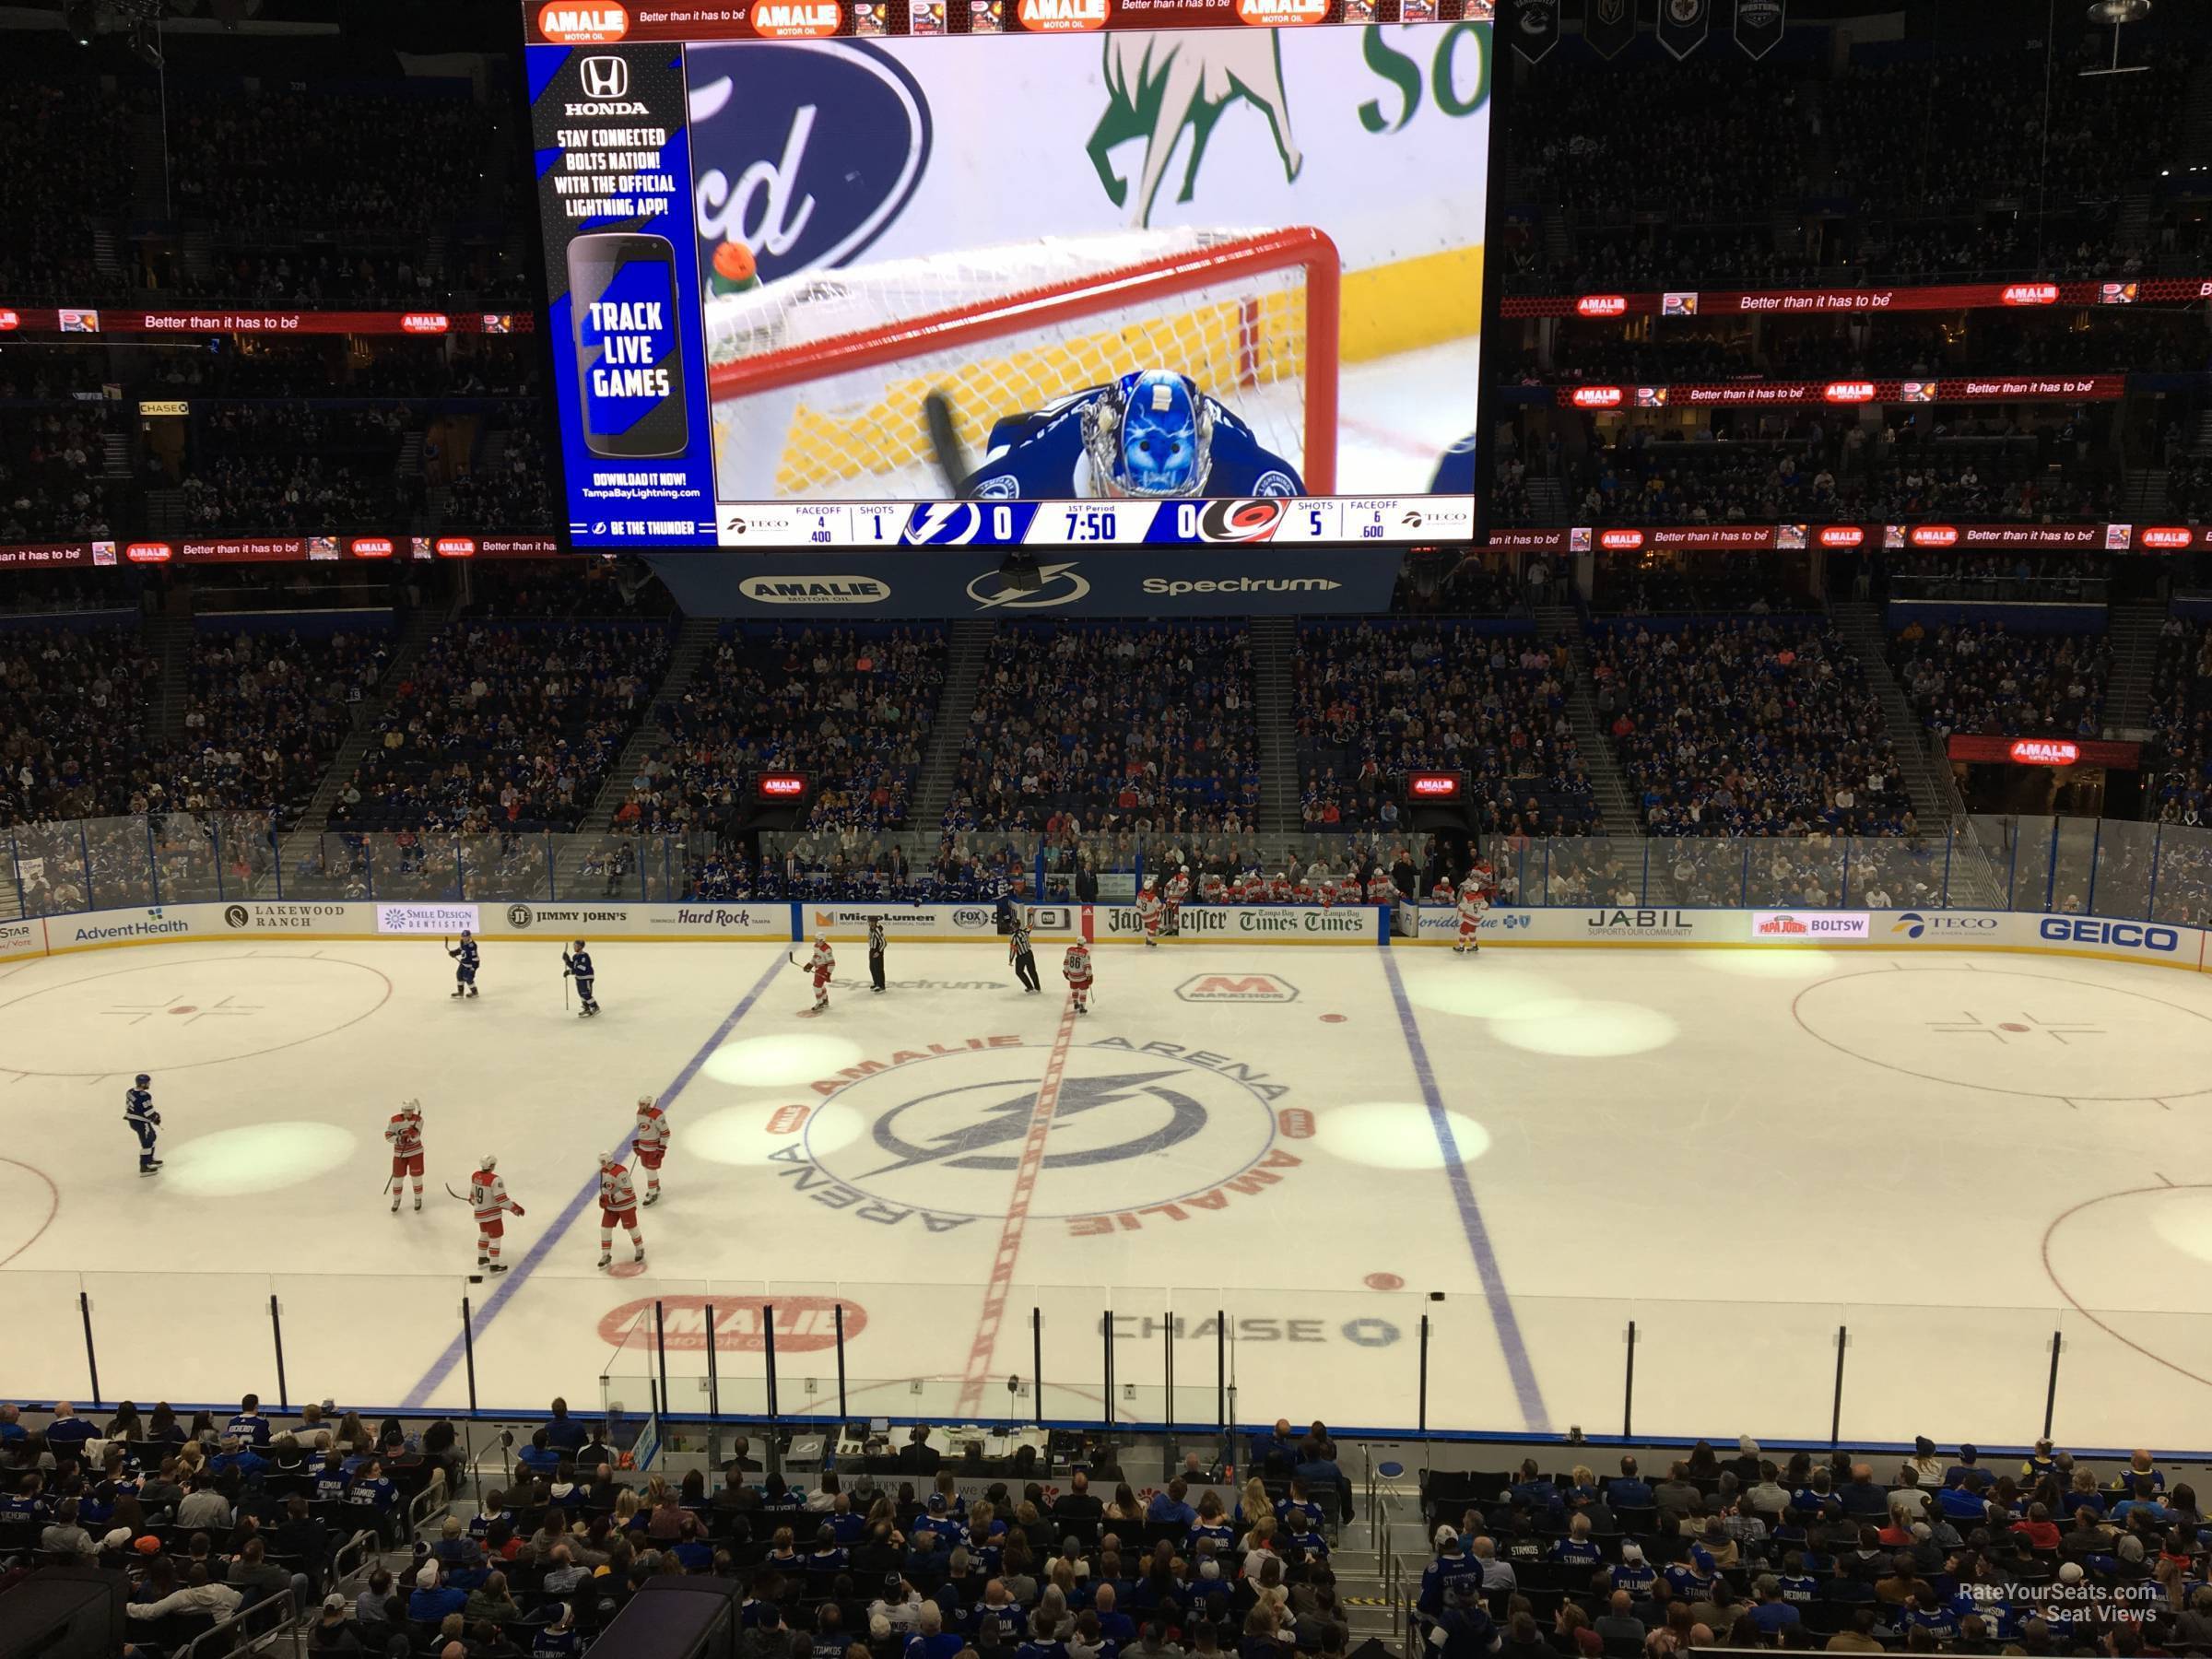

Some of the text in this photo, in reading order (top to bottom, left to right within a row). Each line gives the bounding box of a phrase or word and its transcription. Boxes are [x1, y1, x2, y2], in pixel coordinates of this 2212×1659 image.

[1024, 0, 1105, 19] AMALIE
[545, 10, 624, 31] AMALIE
[640, 10, 745, 22] Better than it has to be
[757, 5, 836, 27] AMALIE
[565, 102, 649, 115] HONDA
[557, 128, 665, 147] STAY CONNECTED
[566, 152, 660, 171] BOLTS NATION!
[554, 175, 676, 194] WITH THE OFFICIAL
[565, 198, 668, 217] LIGHTNING APP!
[2006, 288, 2056, 300] AMALIE
[1580, 298, 1625, 310] AMALIE
[1740, 294, 1889, 309] Better than it has to be
[146, 316, 298, 328] Better than it has to be
[404, 316, 447, 326] AMALIE
[590, 302, 662, 331] TRACK
[605, 335, 653, 364] LIVE
[593, 369, 669, 397] GAMES
[1967, 382, 2091, 393] Better than it has to be
[1575, 390, 1620, 401] AMALIE
[1691, 388, 1803, 399] Better than it has to be
[1828, 385, 1873, 396] AMALIE
[594, 473, 687, 486] DOWNLOAD IT NOW!
[582, 488, 700, 500] TampaBayLightning.com
[1086, 505, 1115, 513] Period
[1298, 501, 1333, 510] SHOTS
[818, 517, 825, 528] 4
[874, 515, 882, 539] 1
[994, 506, 1011, 540] 0
[1065, 512, 1116, 540] 7:50
[1178, 504, 1195, 538] 0
[1311, 512, 1322, 535] 5
[1374, 511, 1381, 523] 6
[611, 521, 695, 535] BE THE THUNDER
[1359, 526, 1383, 538] .600
[808, 531, 830, 543] .400
[1604, 535, 1641, 544] AMALIE
[1823, 532, 1861, 541] AMALIE
[1915, 532, 1956, 541] AMALIE
[1968, 531, 2092, 540] Better than it has to be
[2146, 533, 2189, 542] AMALIE
[130, 547, 170, 558] AMALIE
[184, 545, 215, 553] Better
[218, 544, 239, 553] than
[242, 544, 248, 553] it
[252, 544, 270, 552] has
[286, 544, 298, 552] be
[355, 543, 391, 552] AMALIE
[438, 543, 473, 552] AMALIE
[755, 583, 881, 595] AMALIE
[1143, 577, 1329, 595] Spectrum
[2015, 744, 2076, 757] AMALIE
[766, 781, 800, 789] AMALIE
[1416, 781, 1453, 789] AMALIE
[256, 906, 345, 915] LAKEWOOD
[406, 909, 472, 919] SMILE DESIGN
[959, 912, 981, 921] FOX
[1258, 910, 1294, 918] Tampa Bay
[1323, 910, 1359, 919] Tampa Bay
[257, 917, 312, 926] RANCH
[536, 912, 627, 922] JIMMY JOHN'S
[678, 910, 749, 926] Hard Rock
[840, 913, 935, 922] MicoLumen
[1240, 911, 1298, 931] Times
[1304, 912, 1363, 932] Times
[1588, 909, 1692, 927] JABIL
[1759, 922, 1781, 934] PAPA
[1811, 920, 1864, 931] BOLTSW
[1928, 918, 1998, 929] TECO
[1588, 927, 1626, 936] SUPPORTS
[1646, 927, 1693, 935] COMMUNITY
[2040, 918, 2179, 952] GEICO
[1069, 956, 1081, 969] 86
[810, 1034, 1291, 1100] AMALIE ARENA
[768, 1143, 1303, 1238] ARENA AMALIE
[614, 1308, 850, 1335] AMALIE
[1098, 1316, 1327, 1342] CHASE
[1511, 1546, 1538, 1556] STAMKOS
